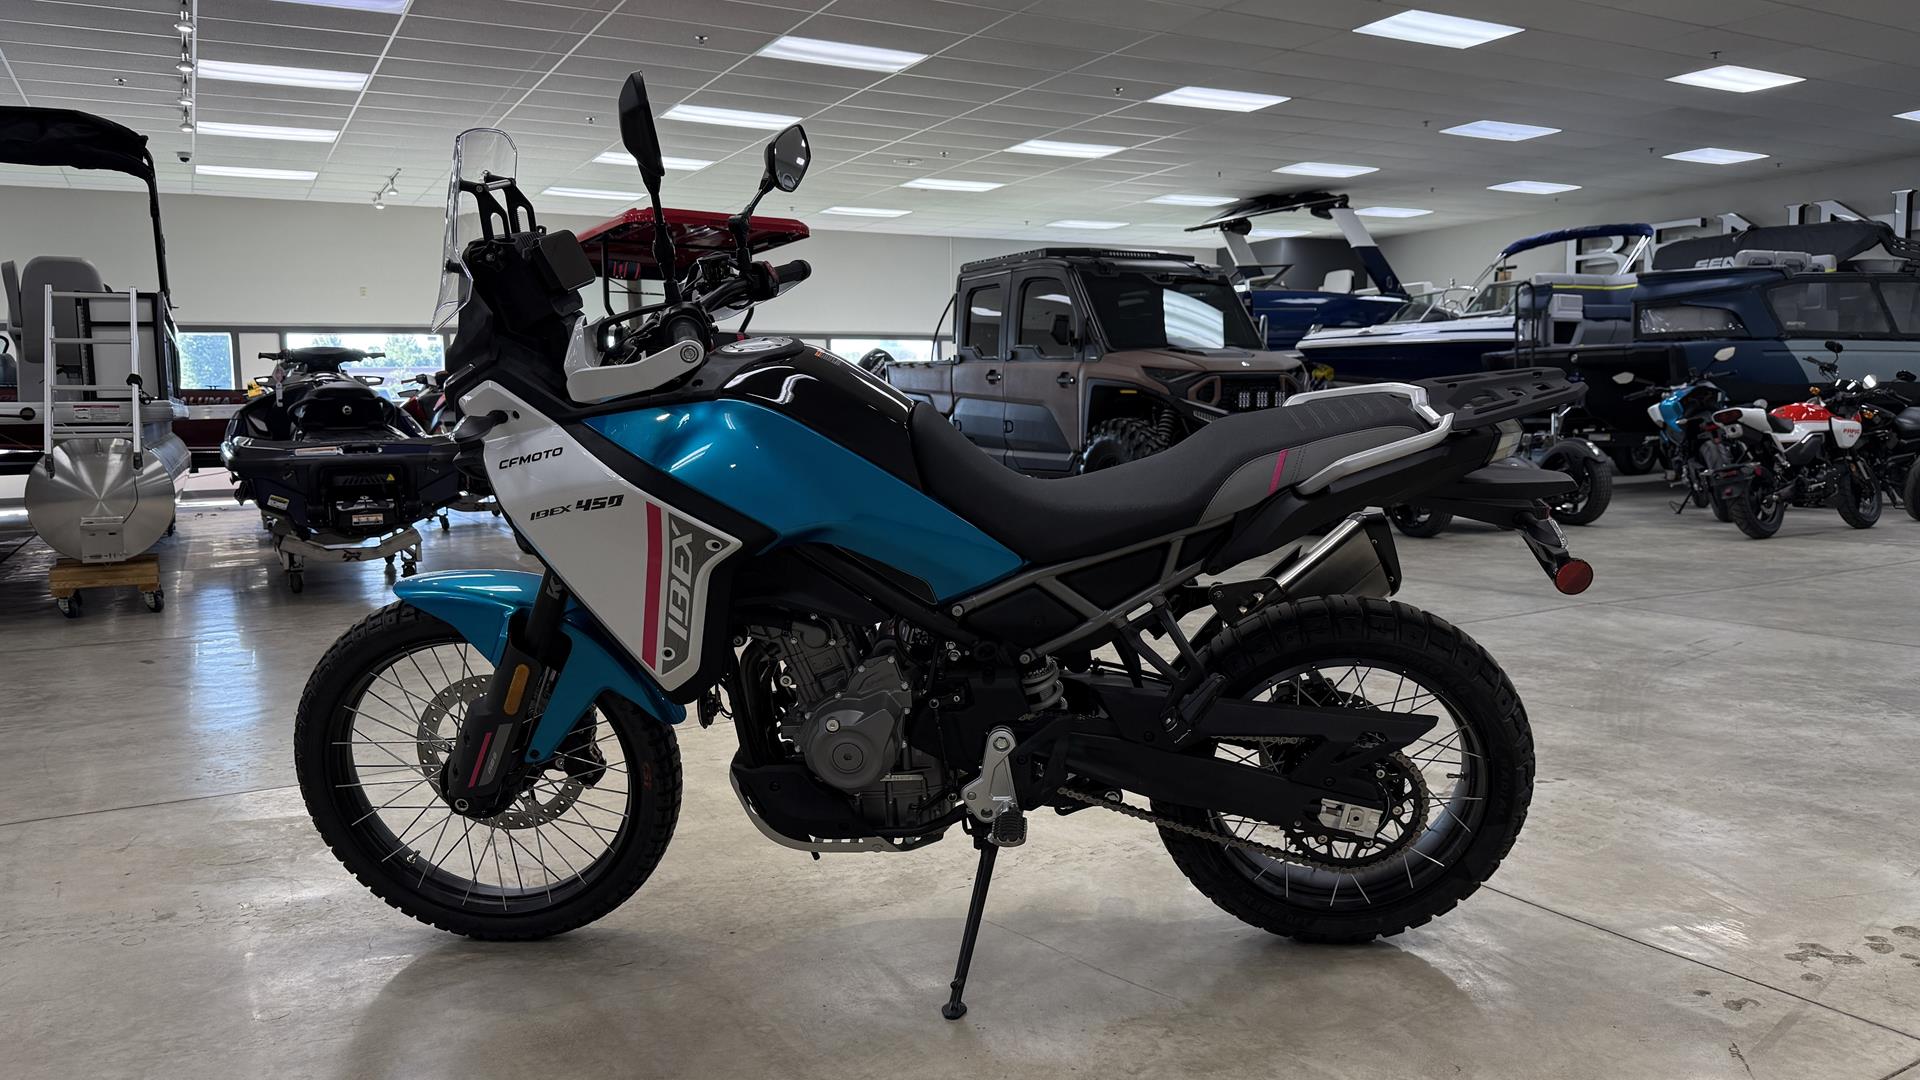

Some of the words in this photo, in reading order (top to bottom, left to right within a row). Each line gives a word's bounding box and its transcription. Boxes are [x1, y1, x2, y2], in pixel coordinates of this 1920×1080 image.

[499, 447, 563, 470] CFMOTO
[530, 504, 572, 521] IBEX
[576, 494, 624, 512] 450
[667, 519, 693, 641] IBEX
